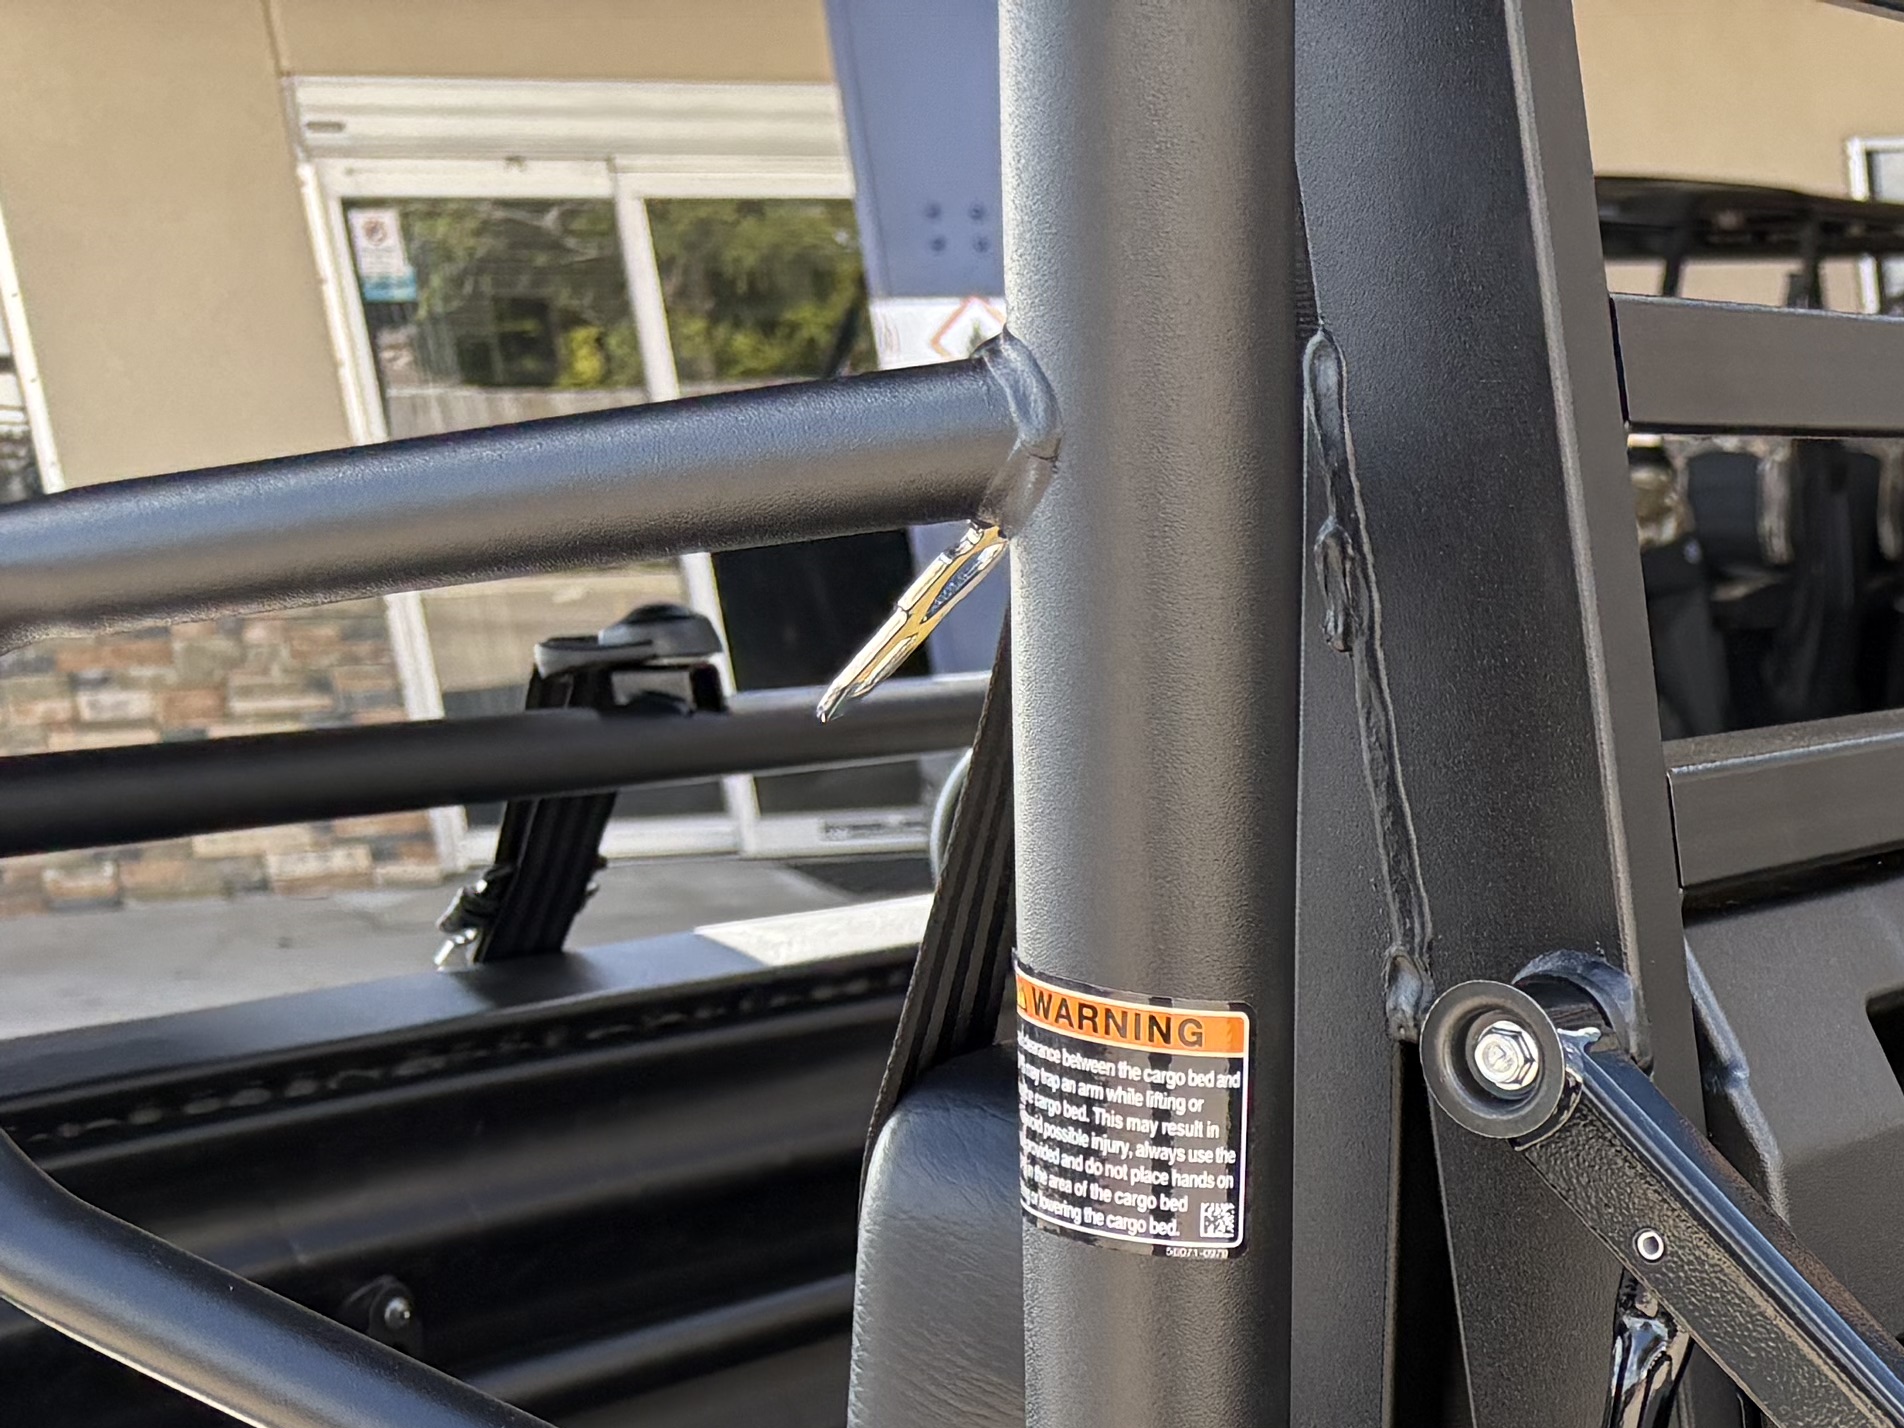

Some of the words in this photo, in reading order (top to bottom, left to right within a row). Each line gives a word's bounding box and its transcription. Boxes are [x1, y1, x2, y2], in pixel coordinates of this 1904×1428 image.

[1031, 987, 1204, 1047] WARNING
[1062, 1048, 1115, 1076] between
[1117, 1060, 1141, 1080] the
[1143, 1069, 1186, 1089] cargo
[1188, 1068, 1215, 1088] bed
[1216, 1071, 1241, 1089] and
[1041, 1068, 1060, 1092] trap
[1061, 1077, 1076, 1094] an
[1078, 1082, 1104, 1100] arm
[1106, 1085, 1143, 1107] while
[1146, 1090, 1186, 1115] lifting
[1188, 1097, 1205, 1113] or
[1035, 1091, 1061, 1116] cargo
[1063, 1100, 1090, 1122] bed.
[1092, 1106, 1124, 1129] This
[1126, 1117, 1158, 1138] may
[1161, 1120, 1204, 1138] result
[1206, 1120, 1220, 1139] in
[1044, 1121, 1089, 1148] possible
[1091, 1131, 1133, 1160] injury,
[1135, 1141, 1186, 1165] always
[1188, 1148, 1214, 1163] use
[1216, 1146, 1236, 1164] the
[1061, 1152, 1084, 1172] and
[1085, 1156, 1104, 1176] do
[1105, 1164, 1128, 1180] not
[1130, 1165, 1169, 1186] place
[1171, 1169, 1215, 1189] hands
[1216, 1174, 1234, 1189] on
[1049, 1173, 1072, 1193] area
[1074, 1180, 1088, 1197] of
[1090, 1183, 1112, 1203] the
[1114, 1190, 1157, 1212] cargo
[1159, 1193, 1188, 1213] bed
[1083, 1207, 1105, 1226] the
[1106, 1214, 1146, 1236] cargo
[1149, 1215, 1180, 1237] bed.
